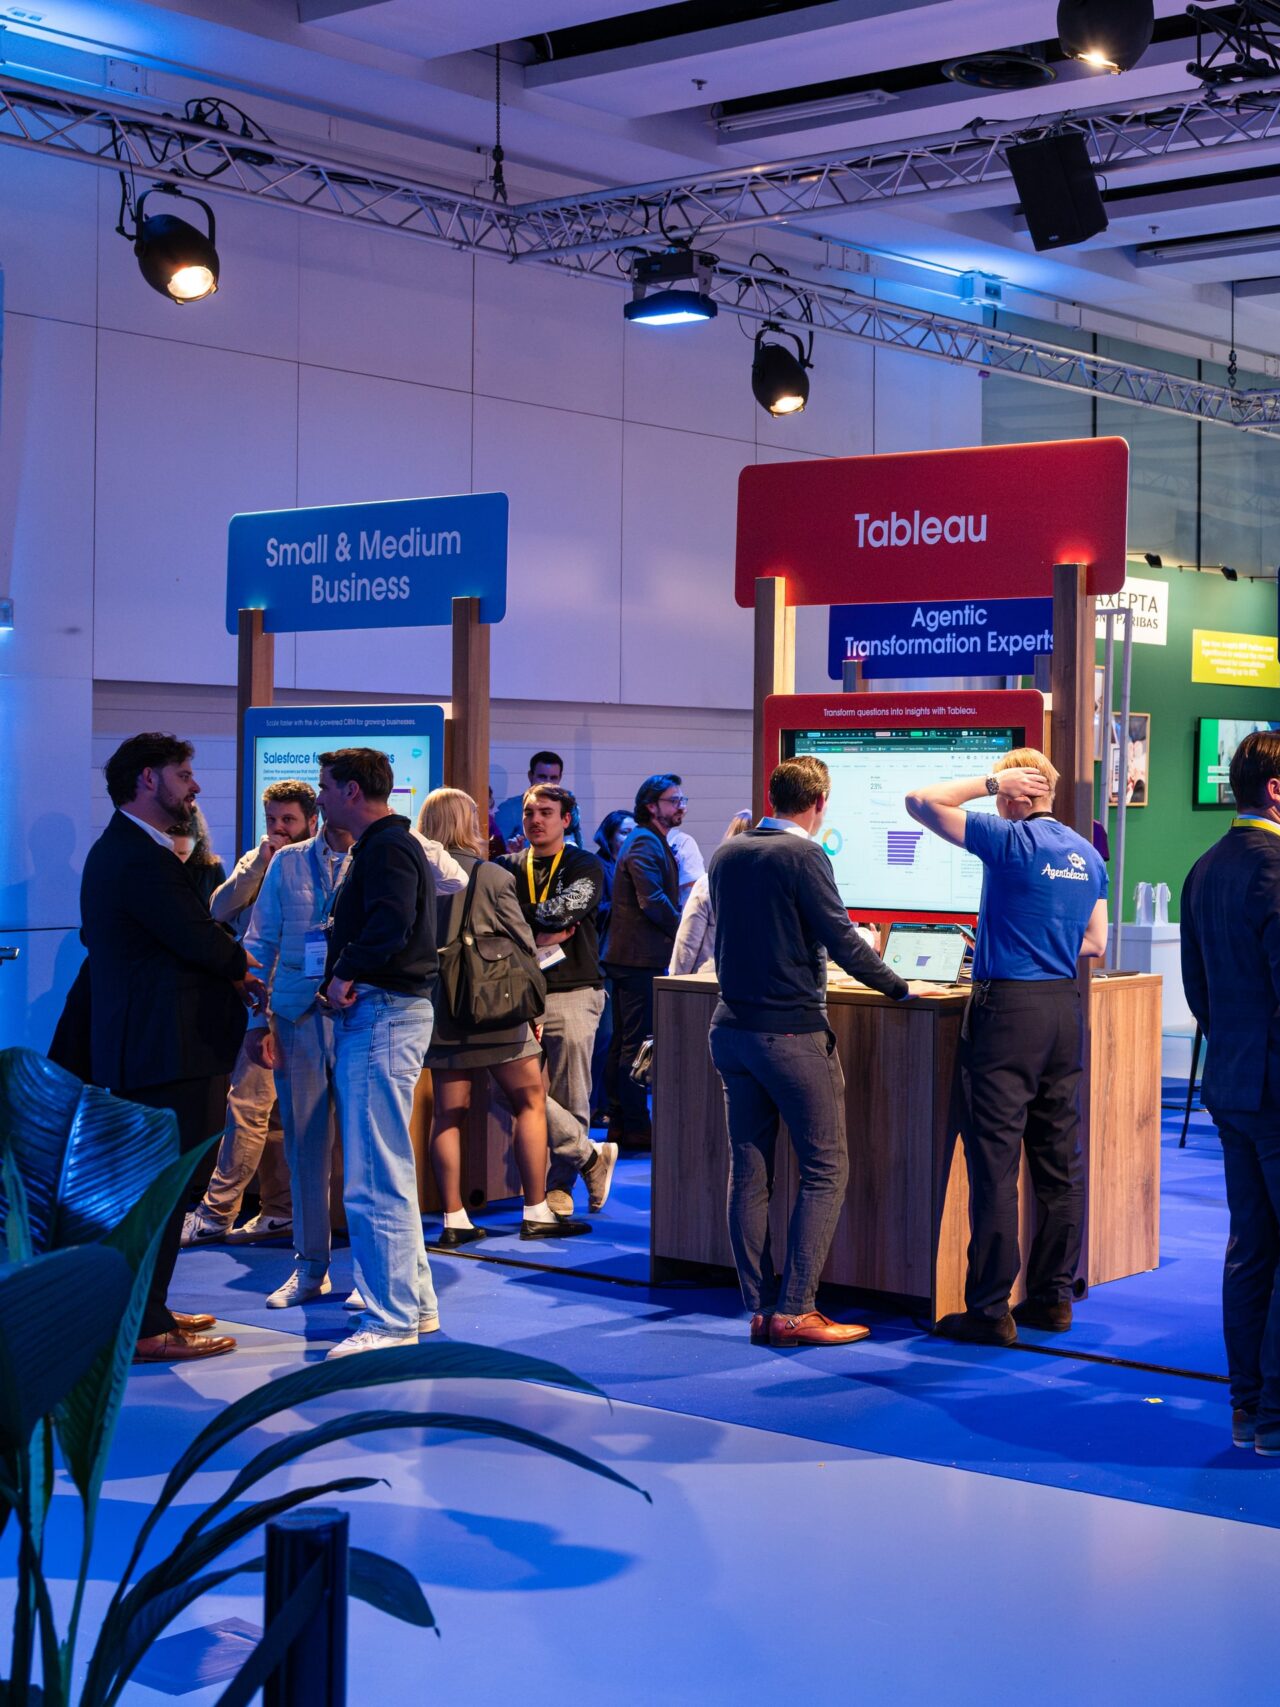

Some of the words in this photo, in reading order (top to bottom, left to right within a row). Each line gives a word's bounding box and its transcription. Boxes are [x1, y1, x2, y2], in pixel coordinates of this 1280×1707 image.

[854, 510, 988, 549] Tableau
[266, 534, 327, 567] Small
[335, 531, 352, 562] &
[359, 527, 461, 560] Medium
[311, 572, 410, 604] Business
[911, 604, 988, 633] Agentic
[845, 634, 981, 659] Transformation
[364, 718, 386, 728] growing
[823, 708, 856, 717] Transform
[857, 708, 889, 718] questions
[890, 707, 904, 716] into
[905, 707, 931, 717] insights
[931, 706, 946, 715] with
[947, 706, 978, 715] Tableau.
[263, 752, 310, 764] Salesforce
